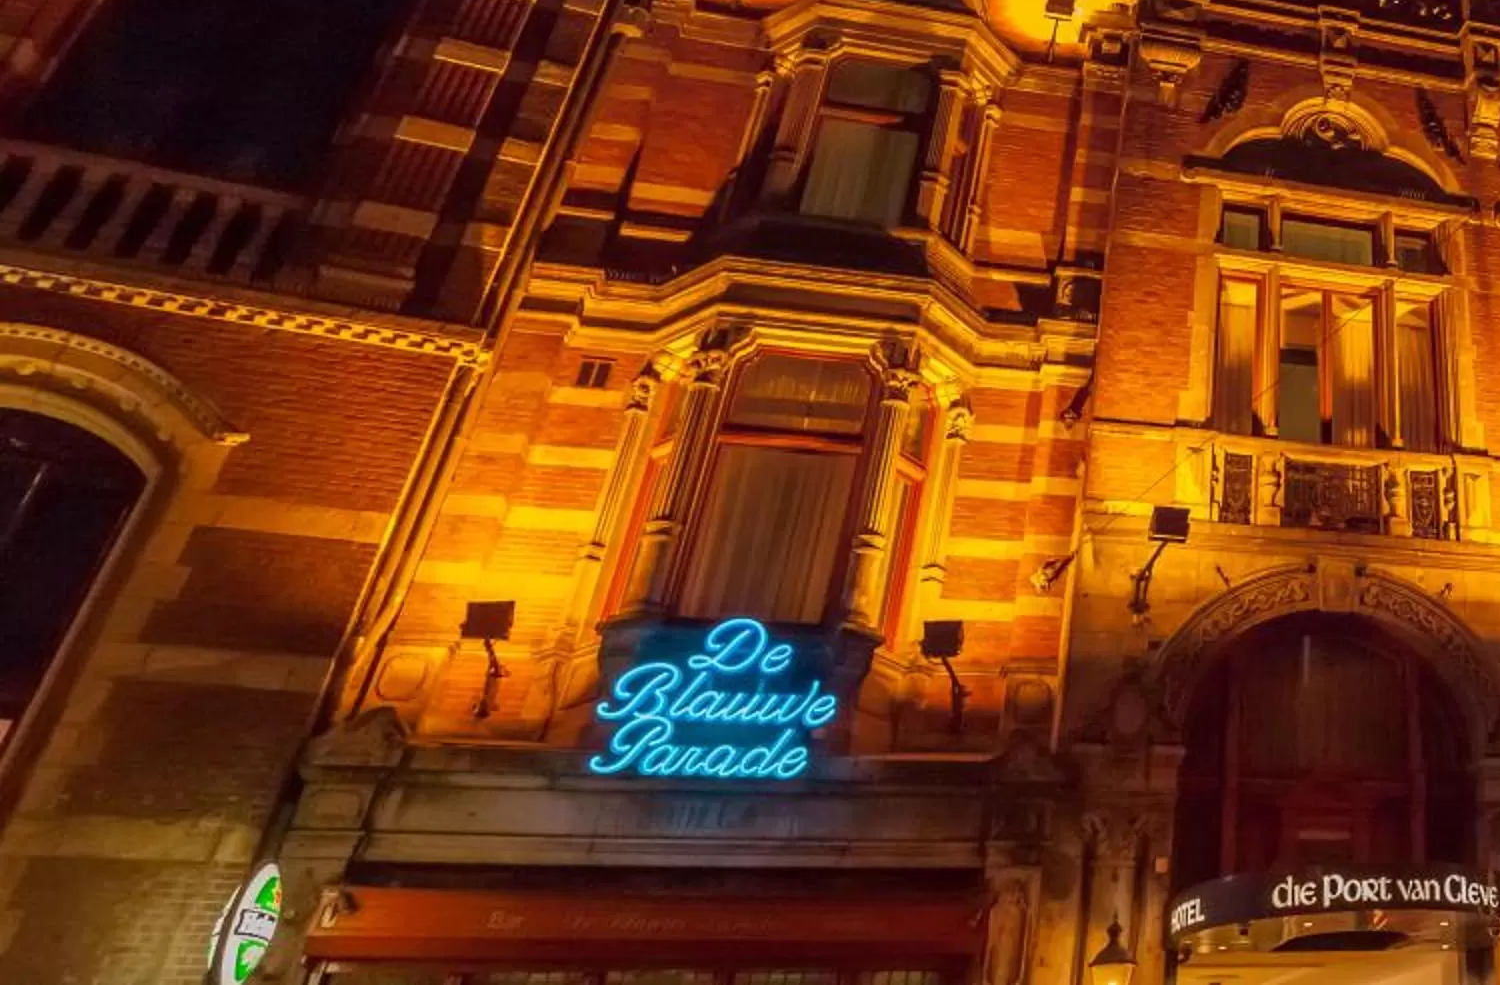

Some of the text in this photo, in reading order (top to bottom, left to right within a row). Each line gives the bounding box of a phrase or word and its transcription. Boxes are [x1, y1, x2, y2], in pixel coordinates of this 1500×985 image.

[687, 616, 794, 674] De
[595, 661, 837, 727] Blauwe
[588, 714, 809, 779] Parade
[1170, 898, 1205, 935] HOTEL
[1271, 874, 1318, 908] die
[1395, 878, 1441, 902] van
